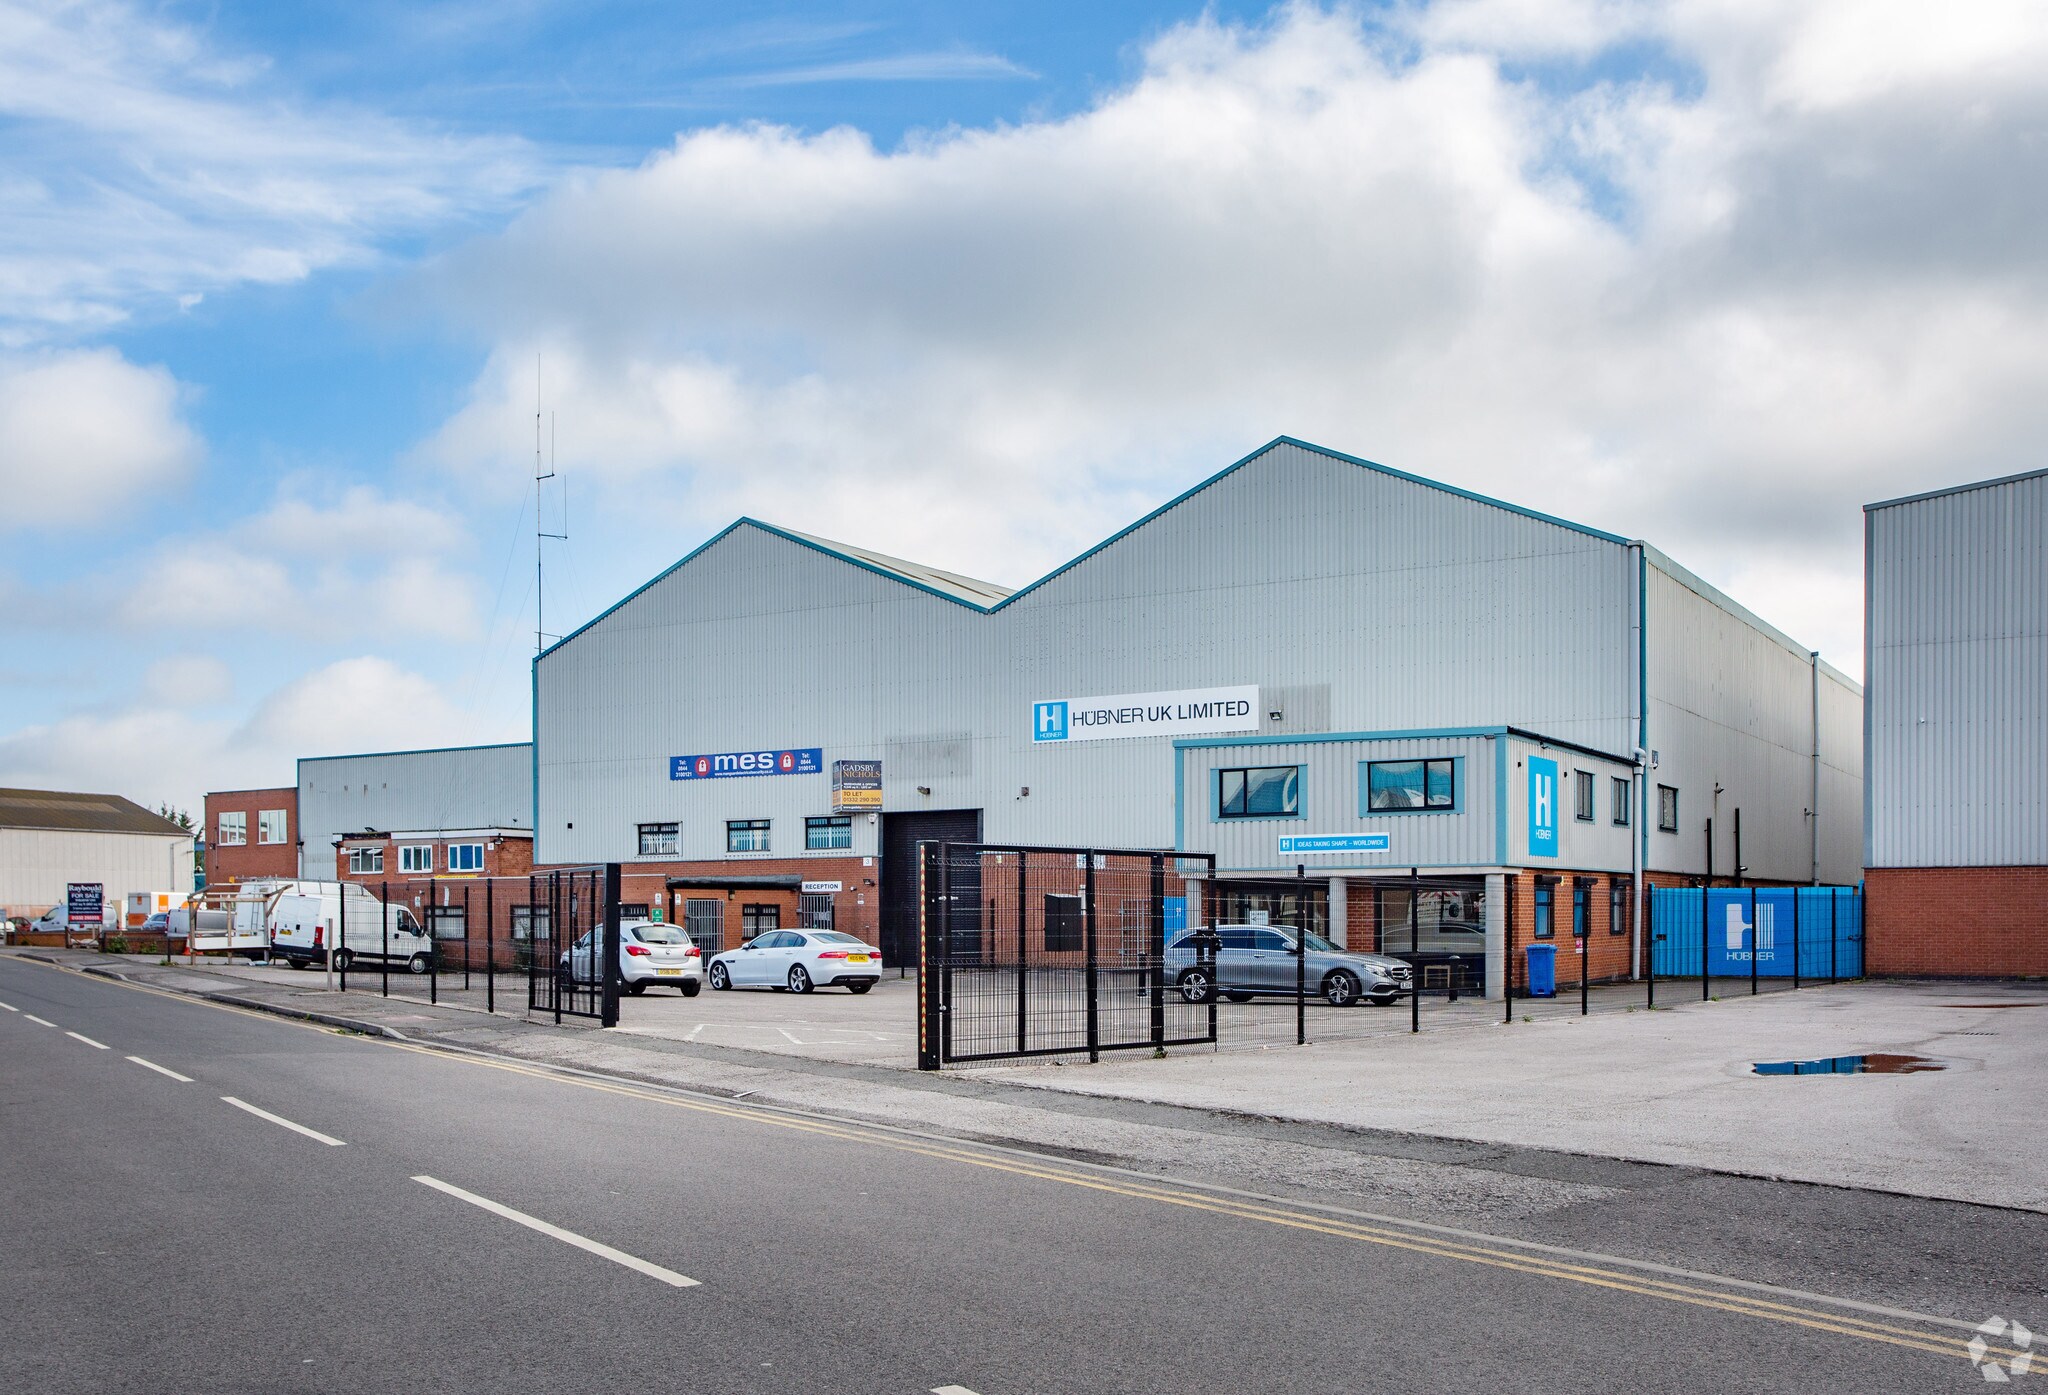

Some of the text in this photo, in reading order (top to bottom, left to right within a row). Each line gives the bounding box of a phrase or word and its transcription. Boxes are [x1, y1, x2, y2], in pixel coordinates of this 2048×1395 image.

[1072, 700, 1250, 727] HÜBNER UK LIMITED
[714, 753, 774, 770] mes
